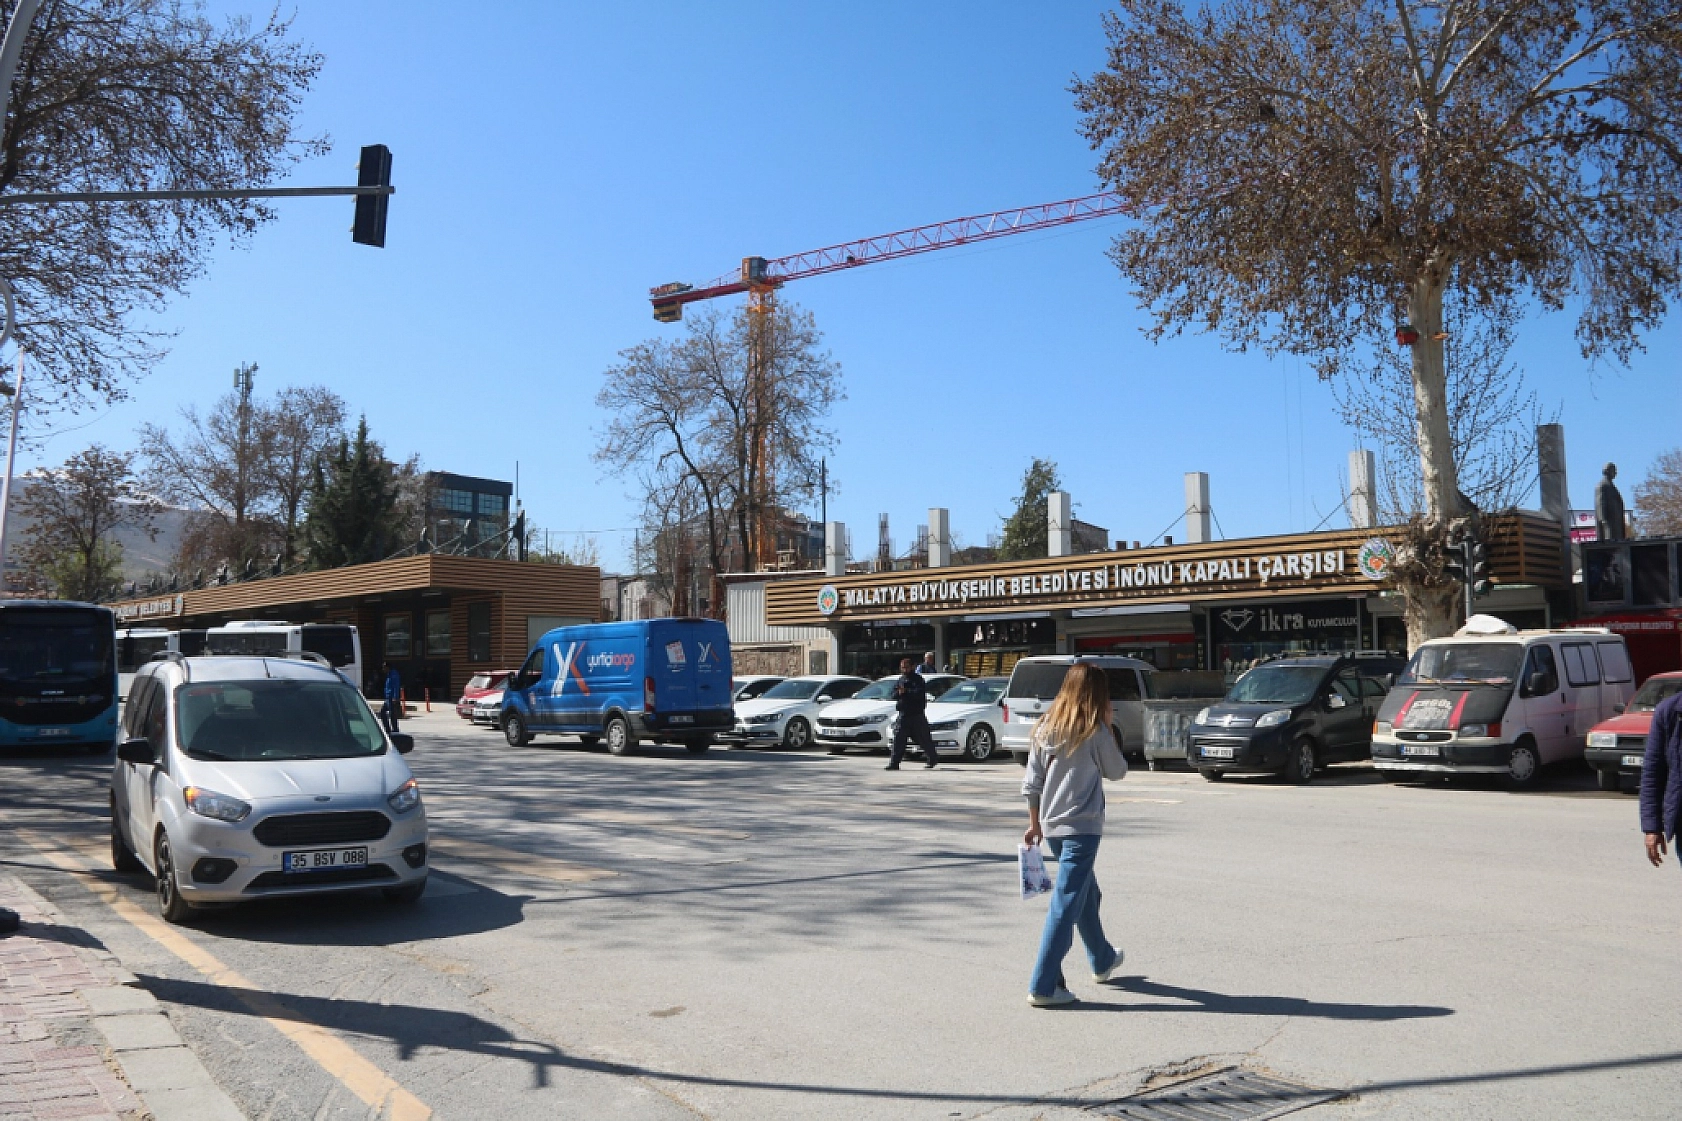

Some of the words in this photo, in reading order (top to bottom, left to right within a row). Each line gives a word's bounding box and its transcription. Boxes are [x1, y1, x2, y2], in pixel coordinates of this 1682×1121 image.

[845, 586, 905, 607] MALATYA
[910, 575, 1006, 603] BÜYÜKŞEHİR
[1011, 566, 1108, 594] BELEDİYESİ
[1114, 560, 1173, 588] İNÖNÜ
[1179, 558, 1250, 583] KAPALI
[1257, 550, 1345, 583] ÇARŞISI
[1260, 608, 1304, 631] ikra
[292, 853, 307, 867] 35
[313, 852, 336, 866] BSV
